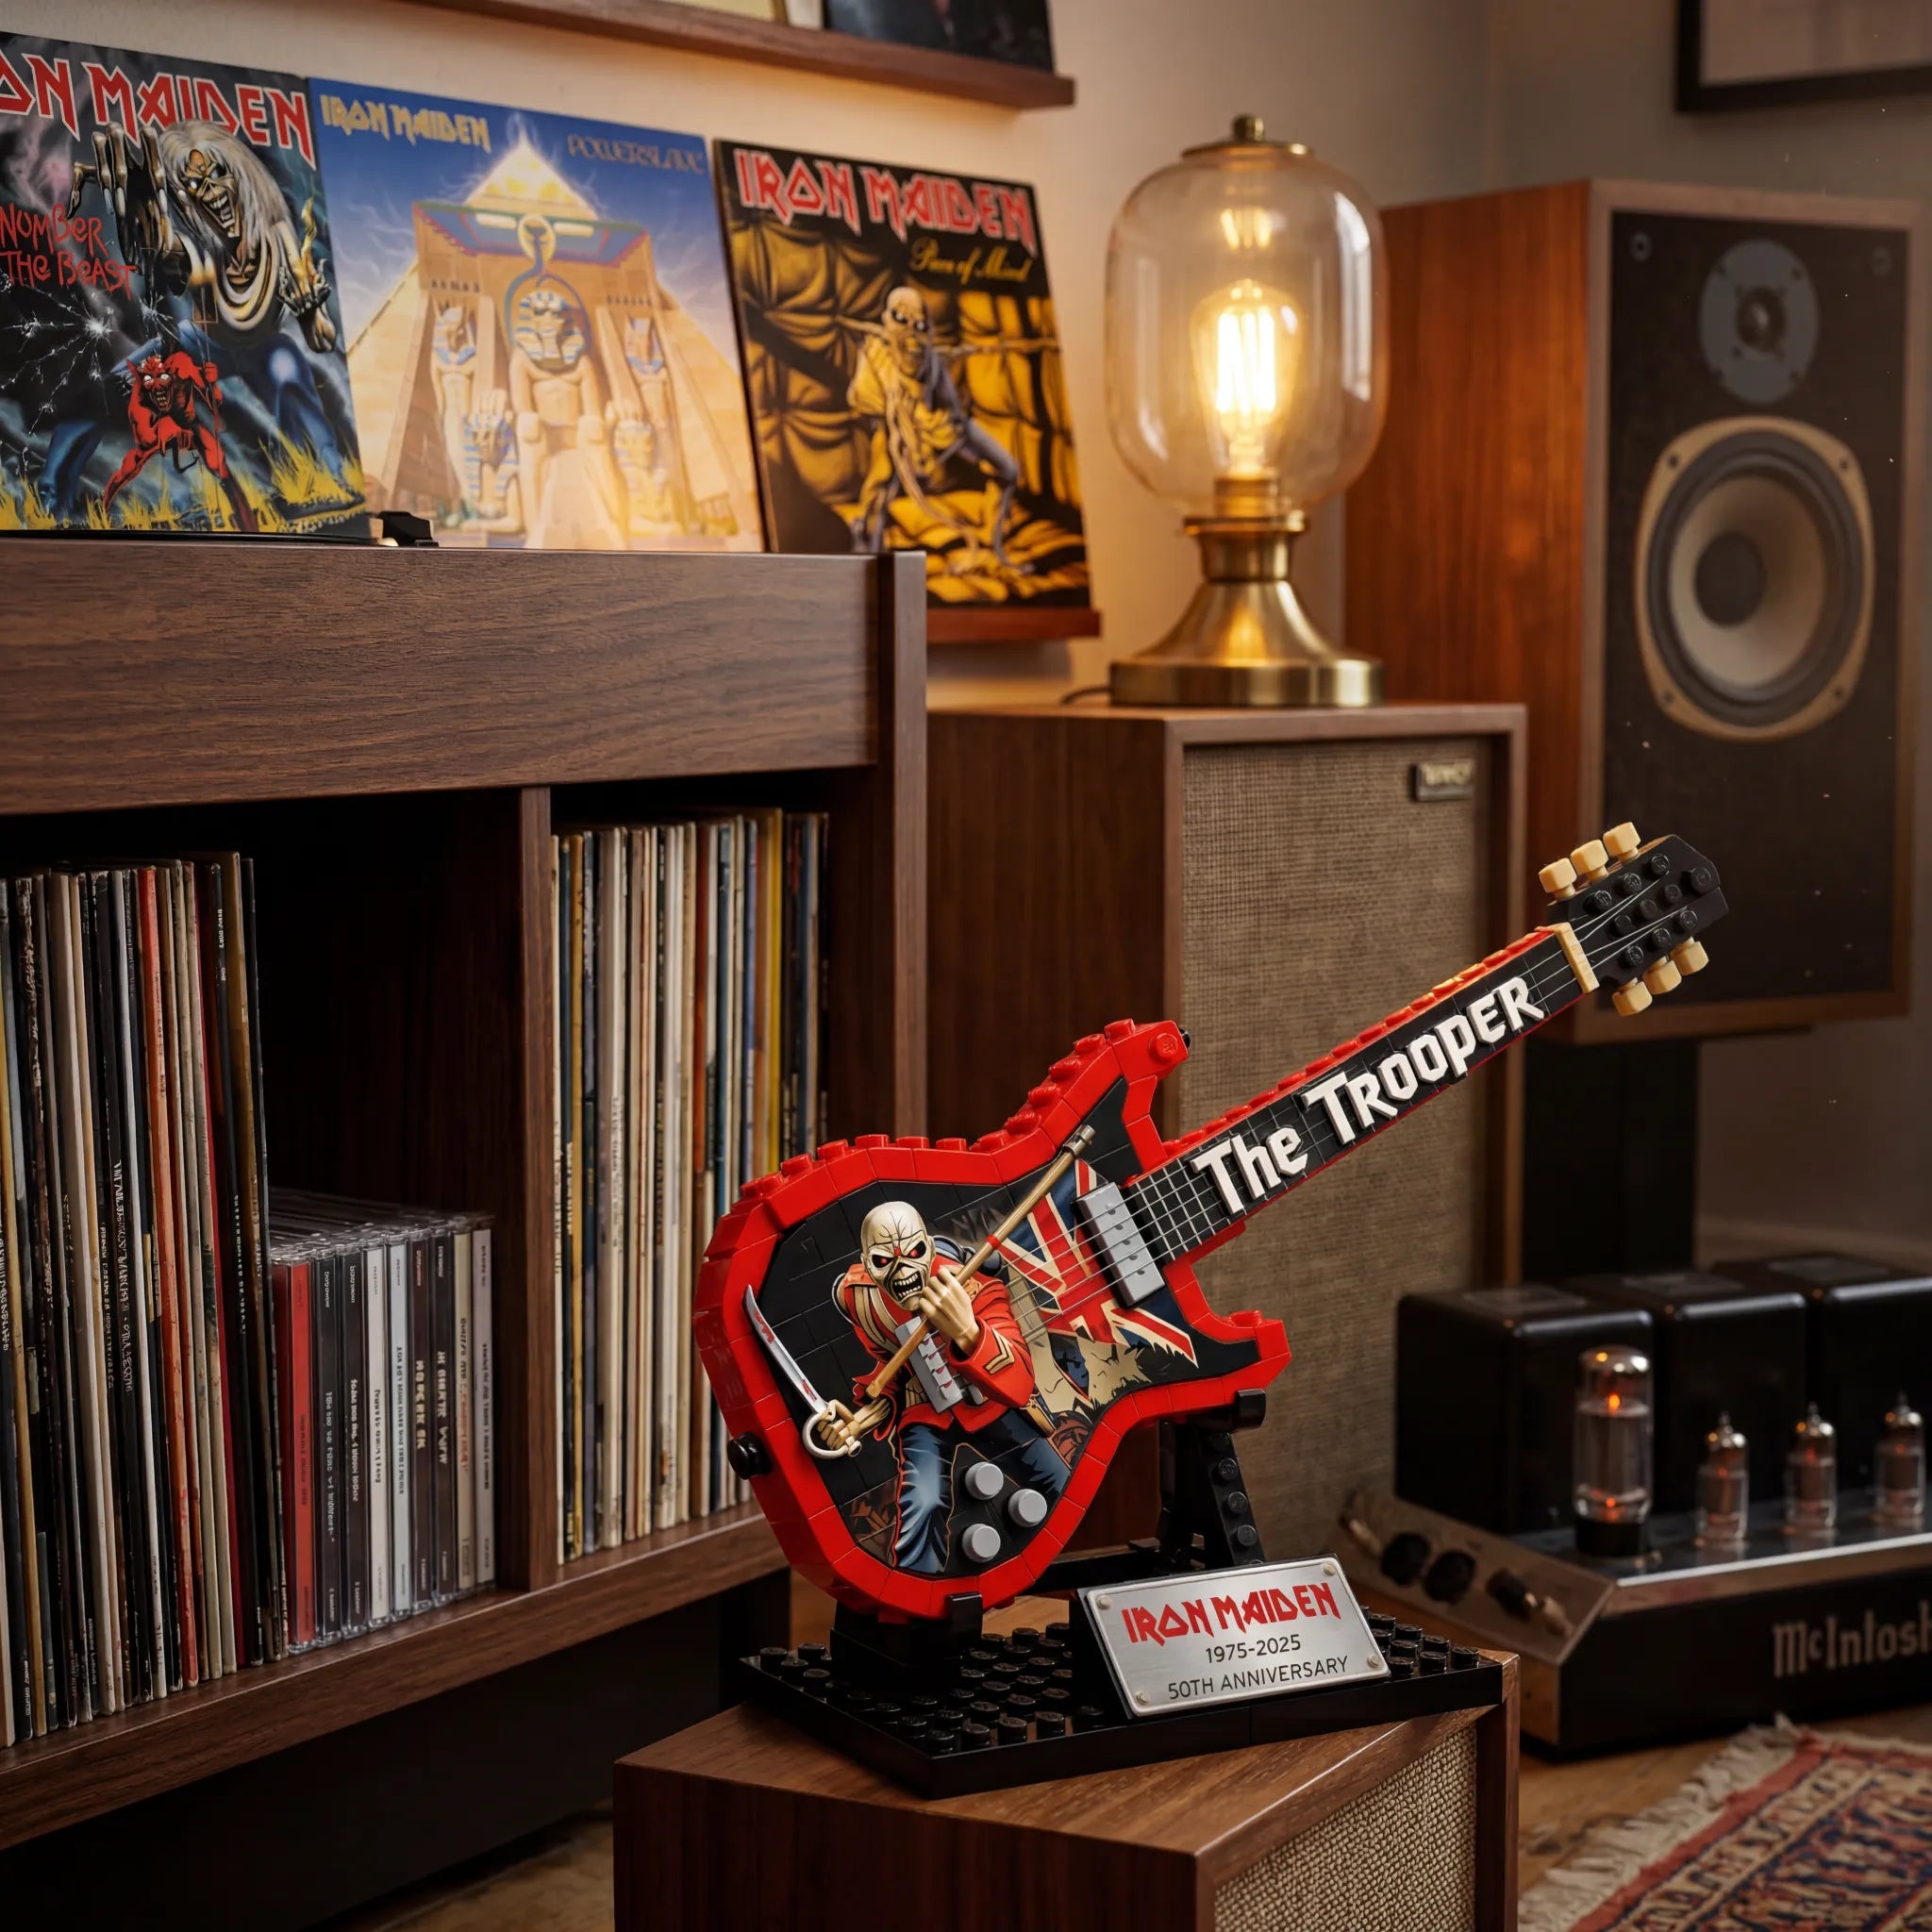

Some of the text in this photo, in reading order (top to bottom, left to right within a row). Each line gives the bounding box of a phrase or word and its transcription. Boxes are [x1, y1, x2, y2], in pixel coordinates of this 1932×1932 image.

[81, 61, 317, 171] MAIDEN
[320, 93, 491, 155] IRON MAIDEN
[733, 147, 862, 237] IRON
[858, 164, 1038, 259] MAIDEN
[1190, 1126, 1308, 1216] The
[1121, 1581, 1341, 1647] IRON MAIDEN
[1167, 1655, 1349, 1700] 50TH ANNIVERSARY
[1205, 1634, 1302, 1664] 1975-2025
